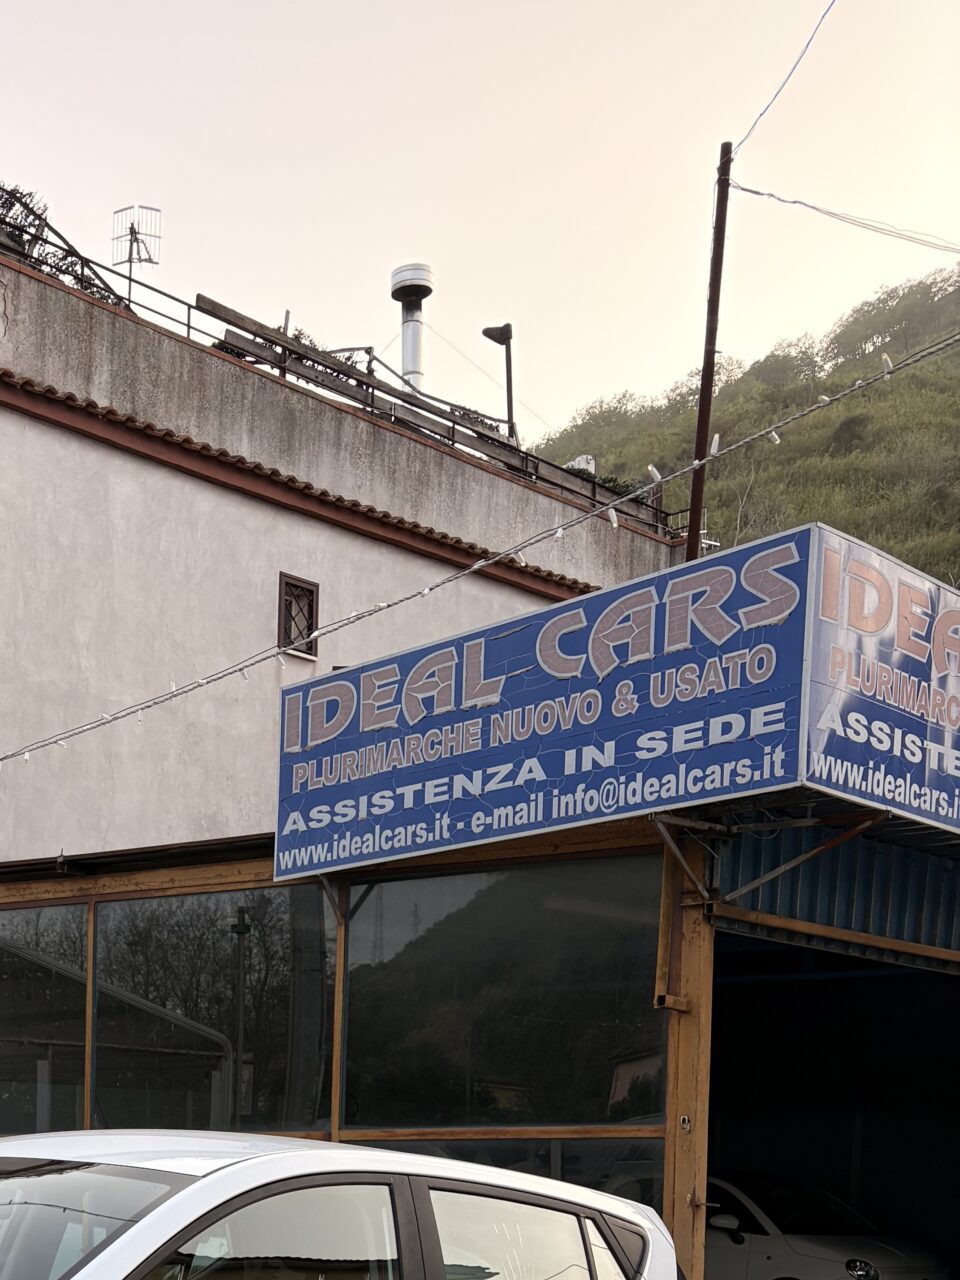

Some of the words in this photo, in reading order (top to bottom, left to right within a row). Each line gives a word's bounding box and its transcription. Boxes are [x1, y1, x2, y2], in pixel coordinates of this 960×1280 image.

[283, 638, 507, 754] IDEAL
[536, 541, 801, 684] CARS
[281, 757, 547, 836] ASSISTENZA
[564, 740, 616, 775] IN
[634, 702, 786, 761] SEDE
[292, 718, 483, 794] PLURIMARCHE
[490, 689, 602, 748] NUOVO
[611, 680, 640, 718] &
[649, 643, 776, 708] USATO
[812, 751, 960, 820] www.idealcars.i
[278, 811, 451, 871] www.idealcars.it
[471, 791, 544, 834] e-mail
[552, 743, 786, 819] info@idealcars.it
